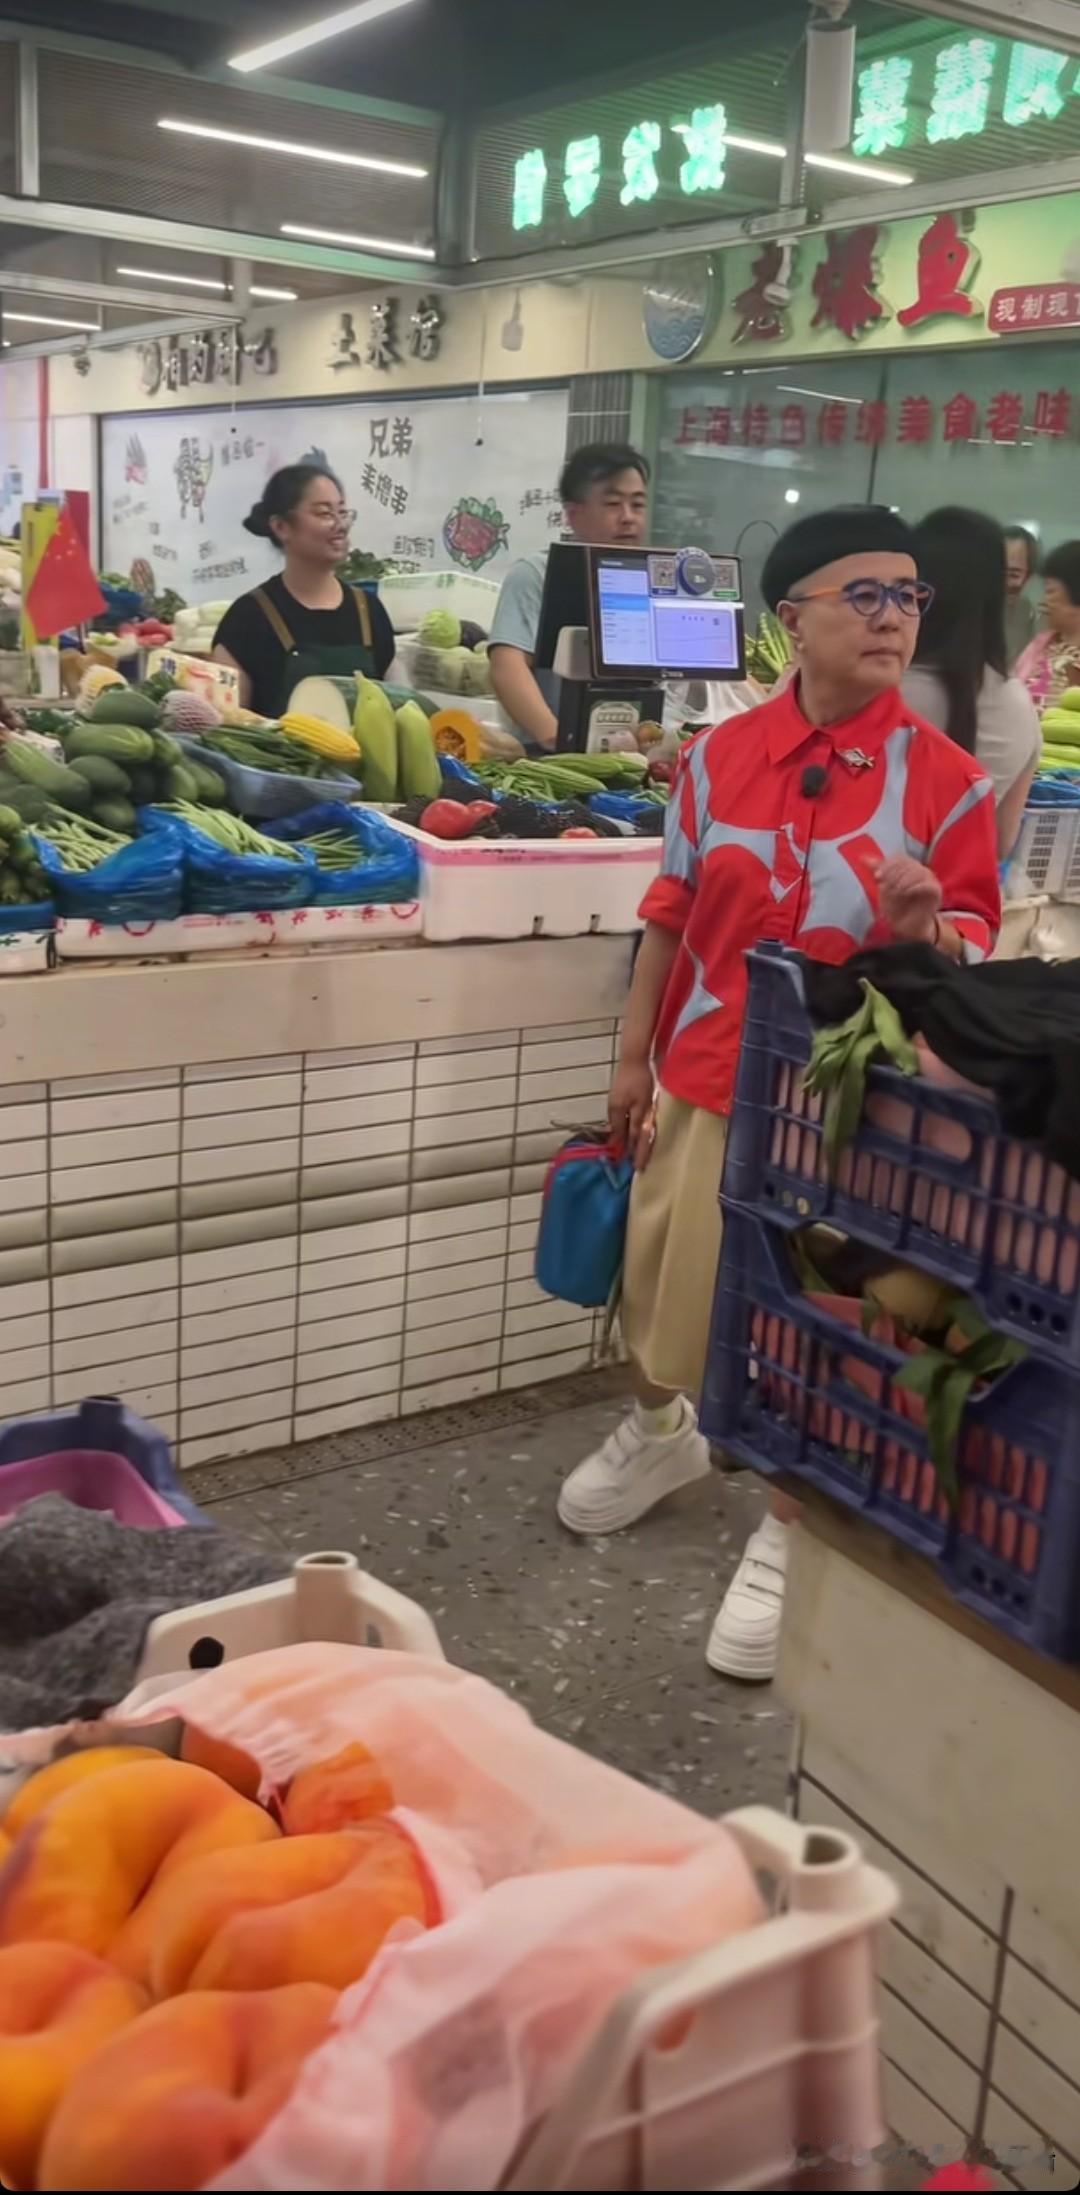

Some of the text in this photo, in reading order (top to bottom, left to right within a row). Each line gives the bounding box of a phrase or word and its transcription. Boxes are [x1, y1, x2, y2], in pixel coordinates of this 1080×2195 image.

[995, 290, 1080, 322] 现制现
[369, 416, 413, 459] 兄弟
